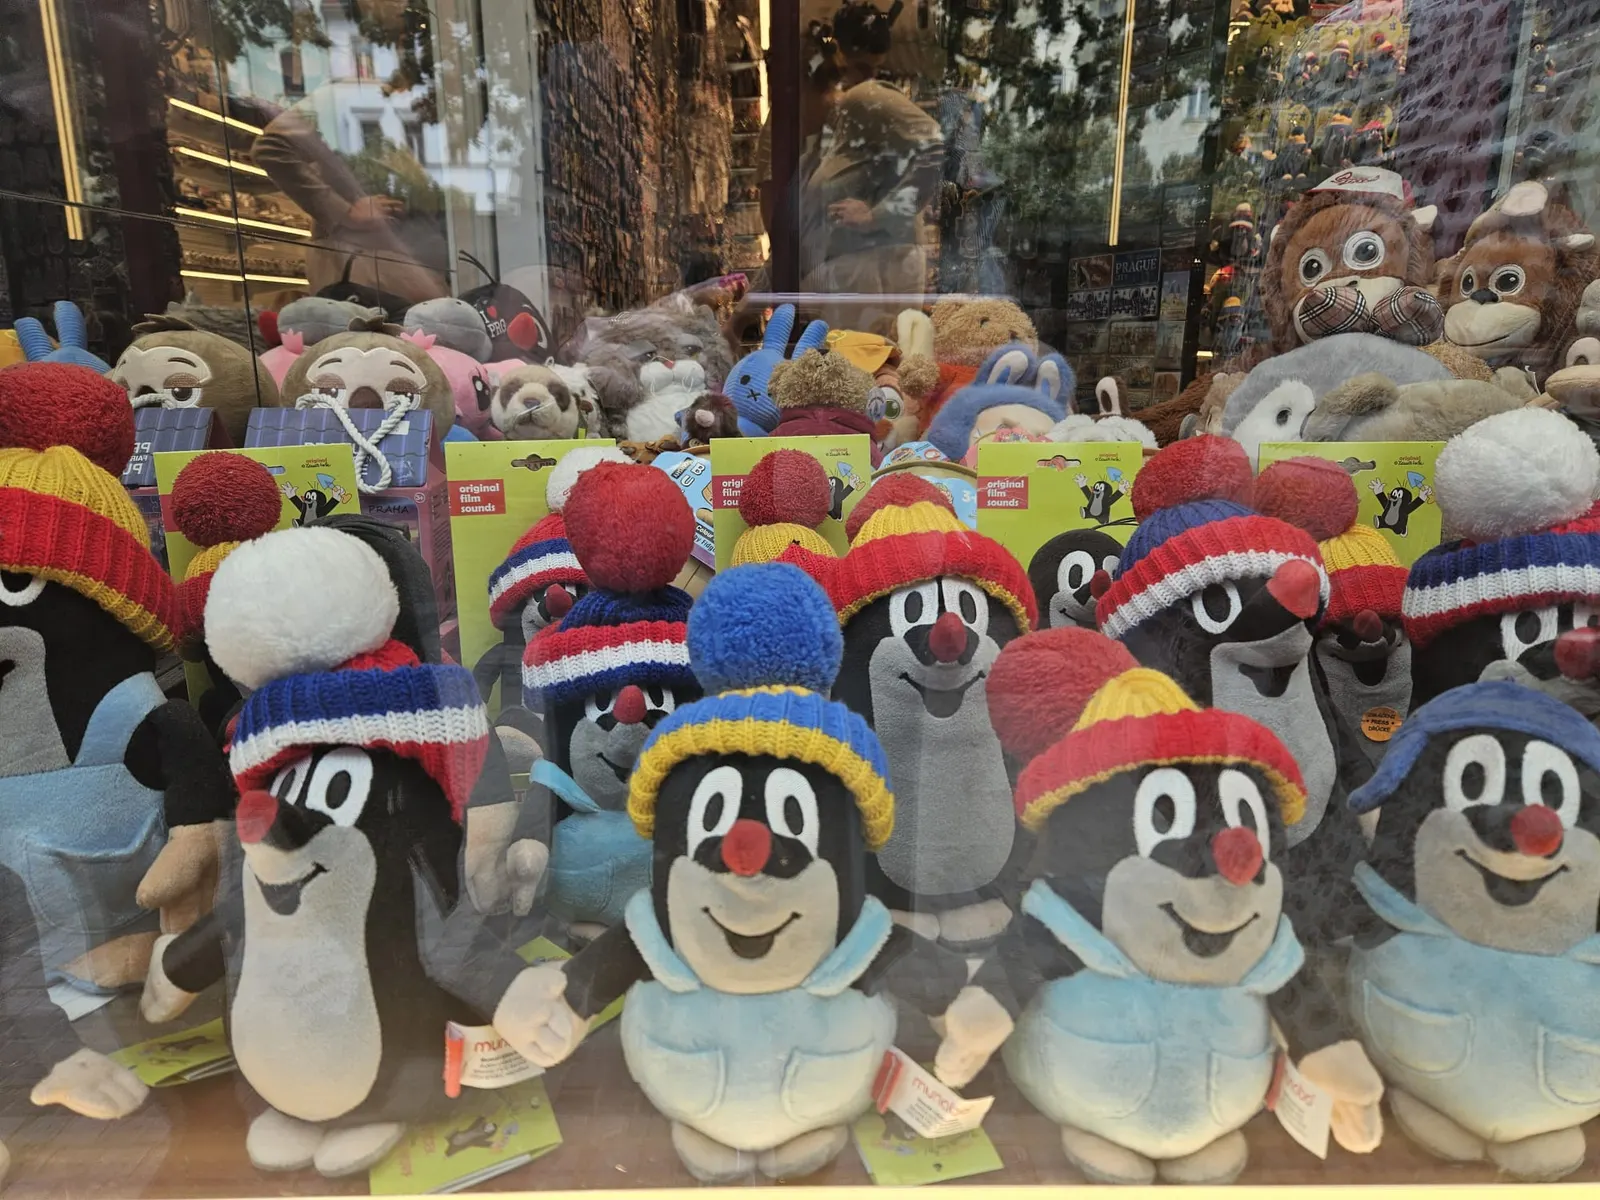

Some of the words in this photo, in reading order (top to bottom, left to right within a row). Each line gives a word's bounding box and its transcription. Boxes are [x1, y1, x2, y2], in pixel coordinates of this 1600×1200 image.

[1115, 257, 1157, 275] PRAGUE
[459, 482, 500, 494] original
[722, 478, 744, 488] origi
[987, 479, 1025, 489] original
[460, 493, 481, 503] film
[987, 489, 1007, 498] film
[987, 498, 1019, 507] sounds
[461, 503, 496, 513] sounds
[695, 525, 714, 539] Colour
